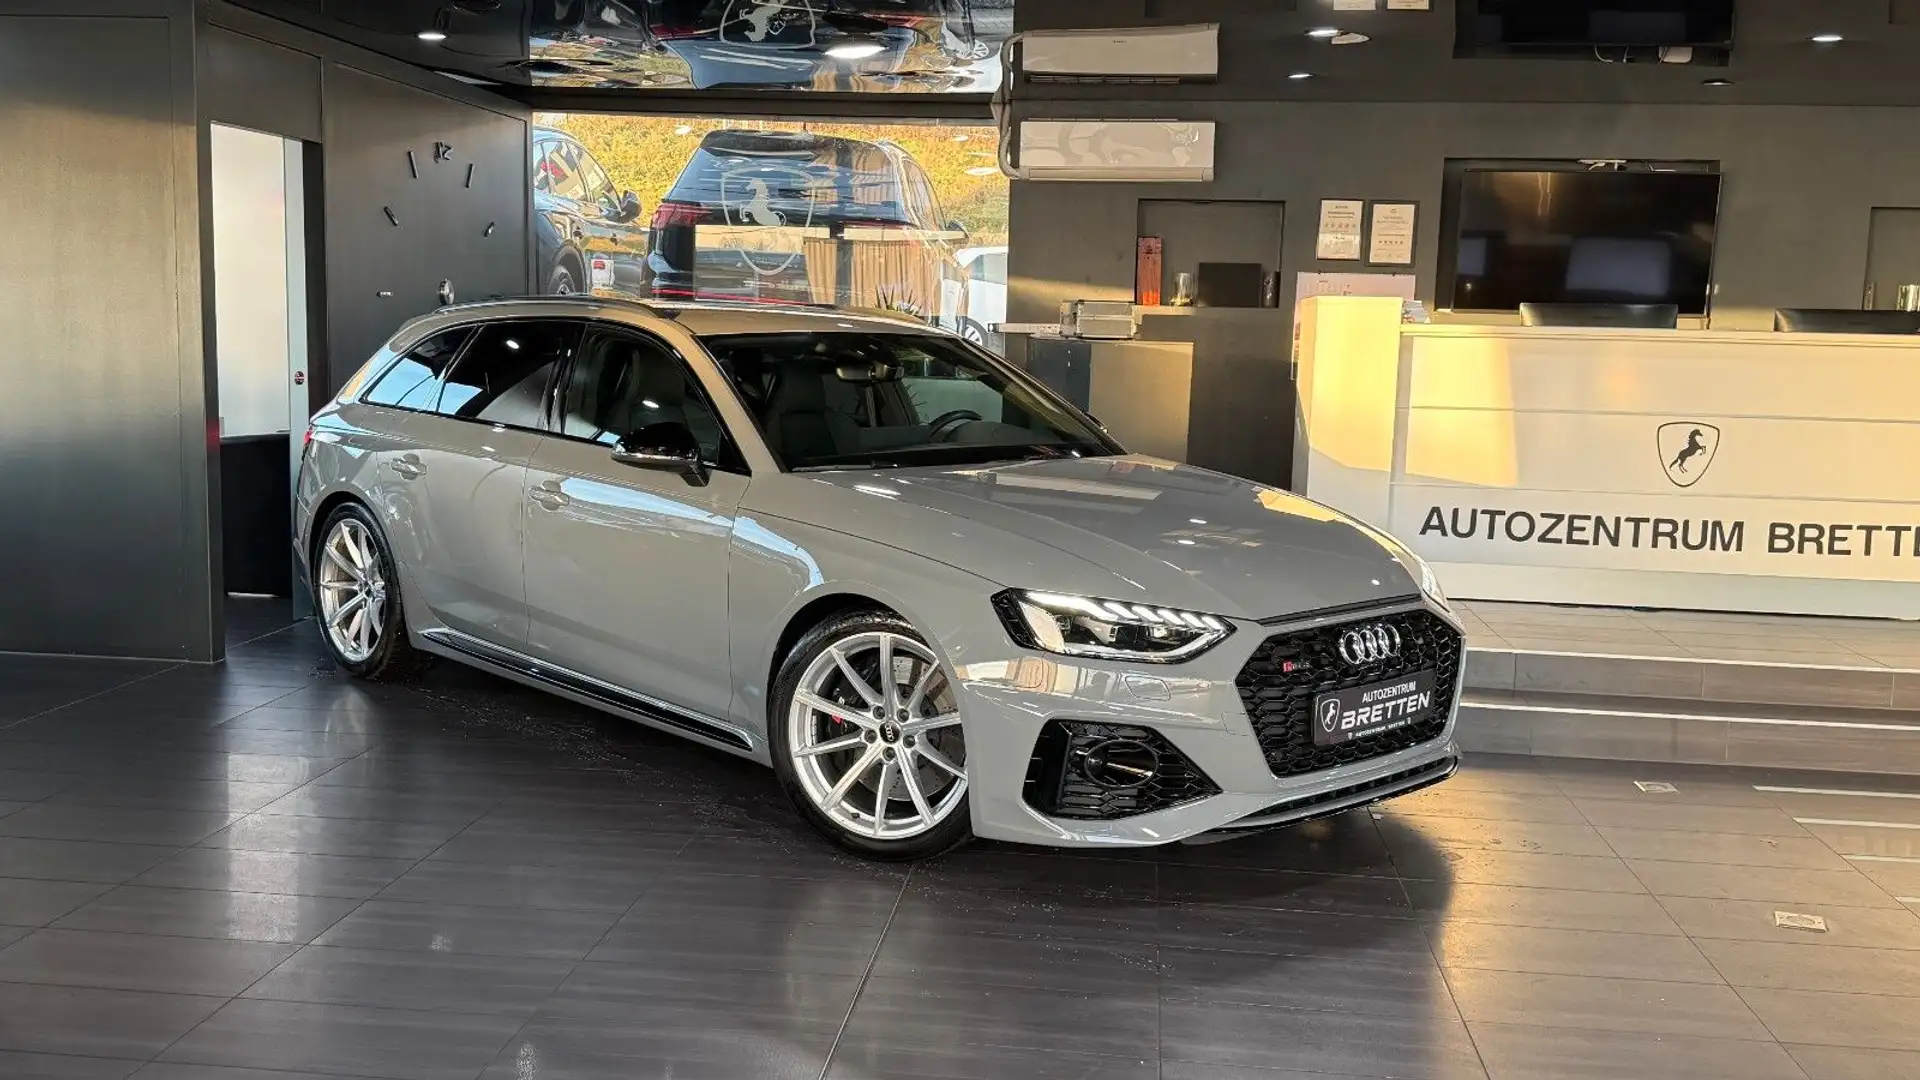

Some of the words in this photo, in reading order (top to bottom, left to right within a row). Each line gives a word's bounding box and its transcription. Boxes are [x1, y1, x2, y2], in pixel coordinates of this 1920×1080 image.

[1419, 506, 1744, 552] AUTOZENTRUM
[1768, 522, 1920, 557] BRETT
[1341, 691, 1430, 729] BRETTEN
[1362, 681, 1416, 703] AUTOZENTRUM
